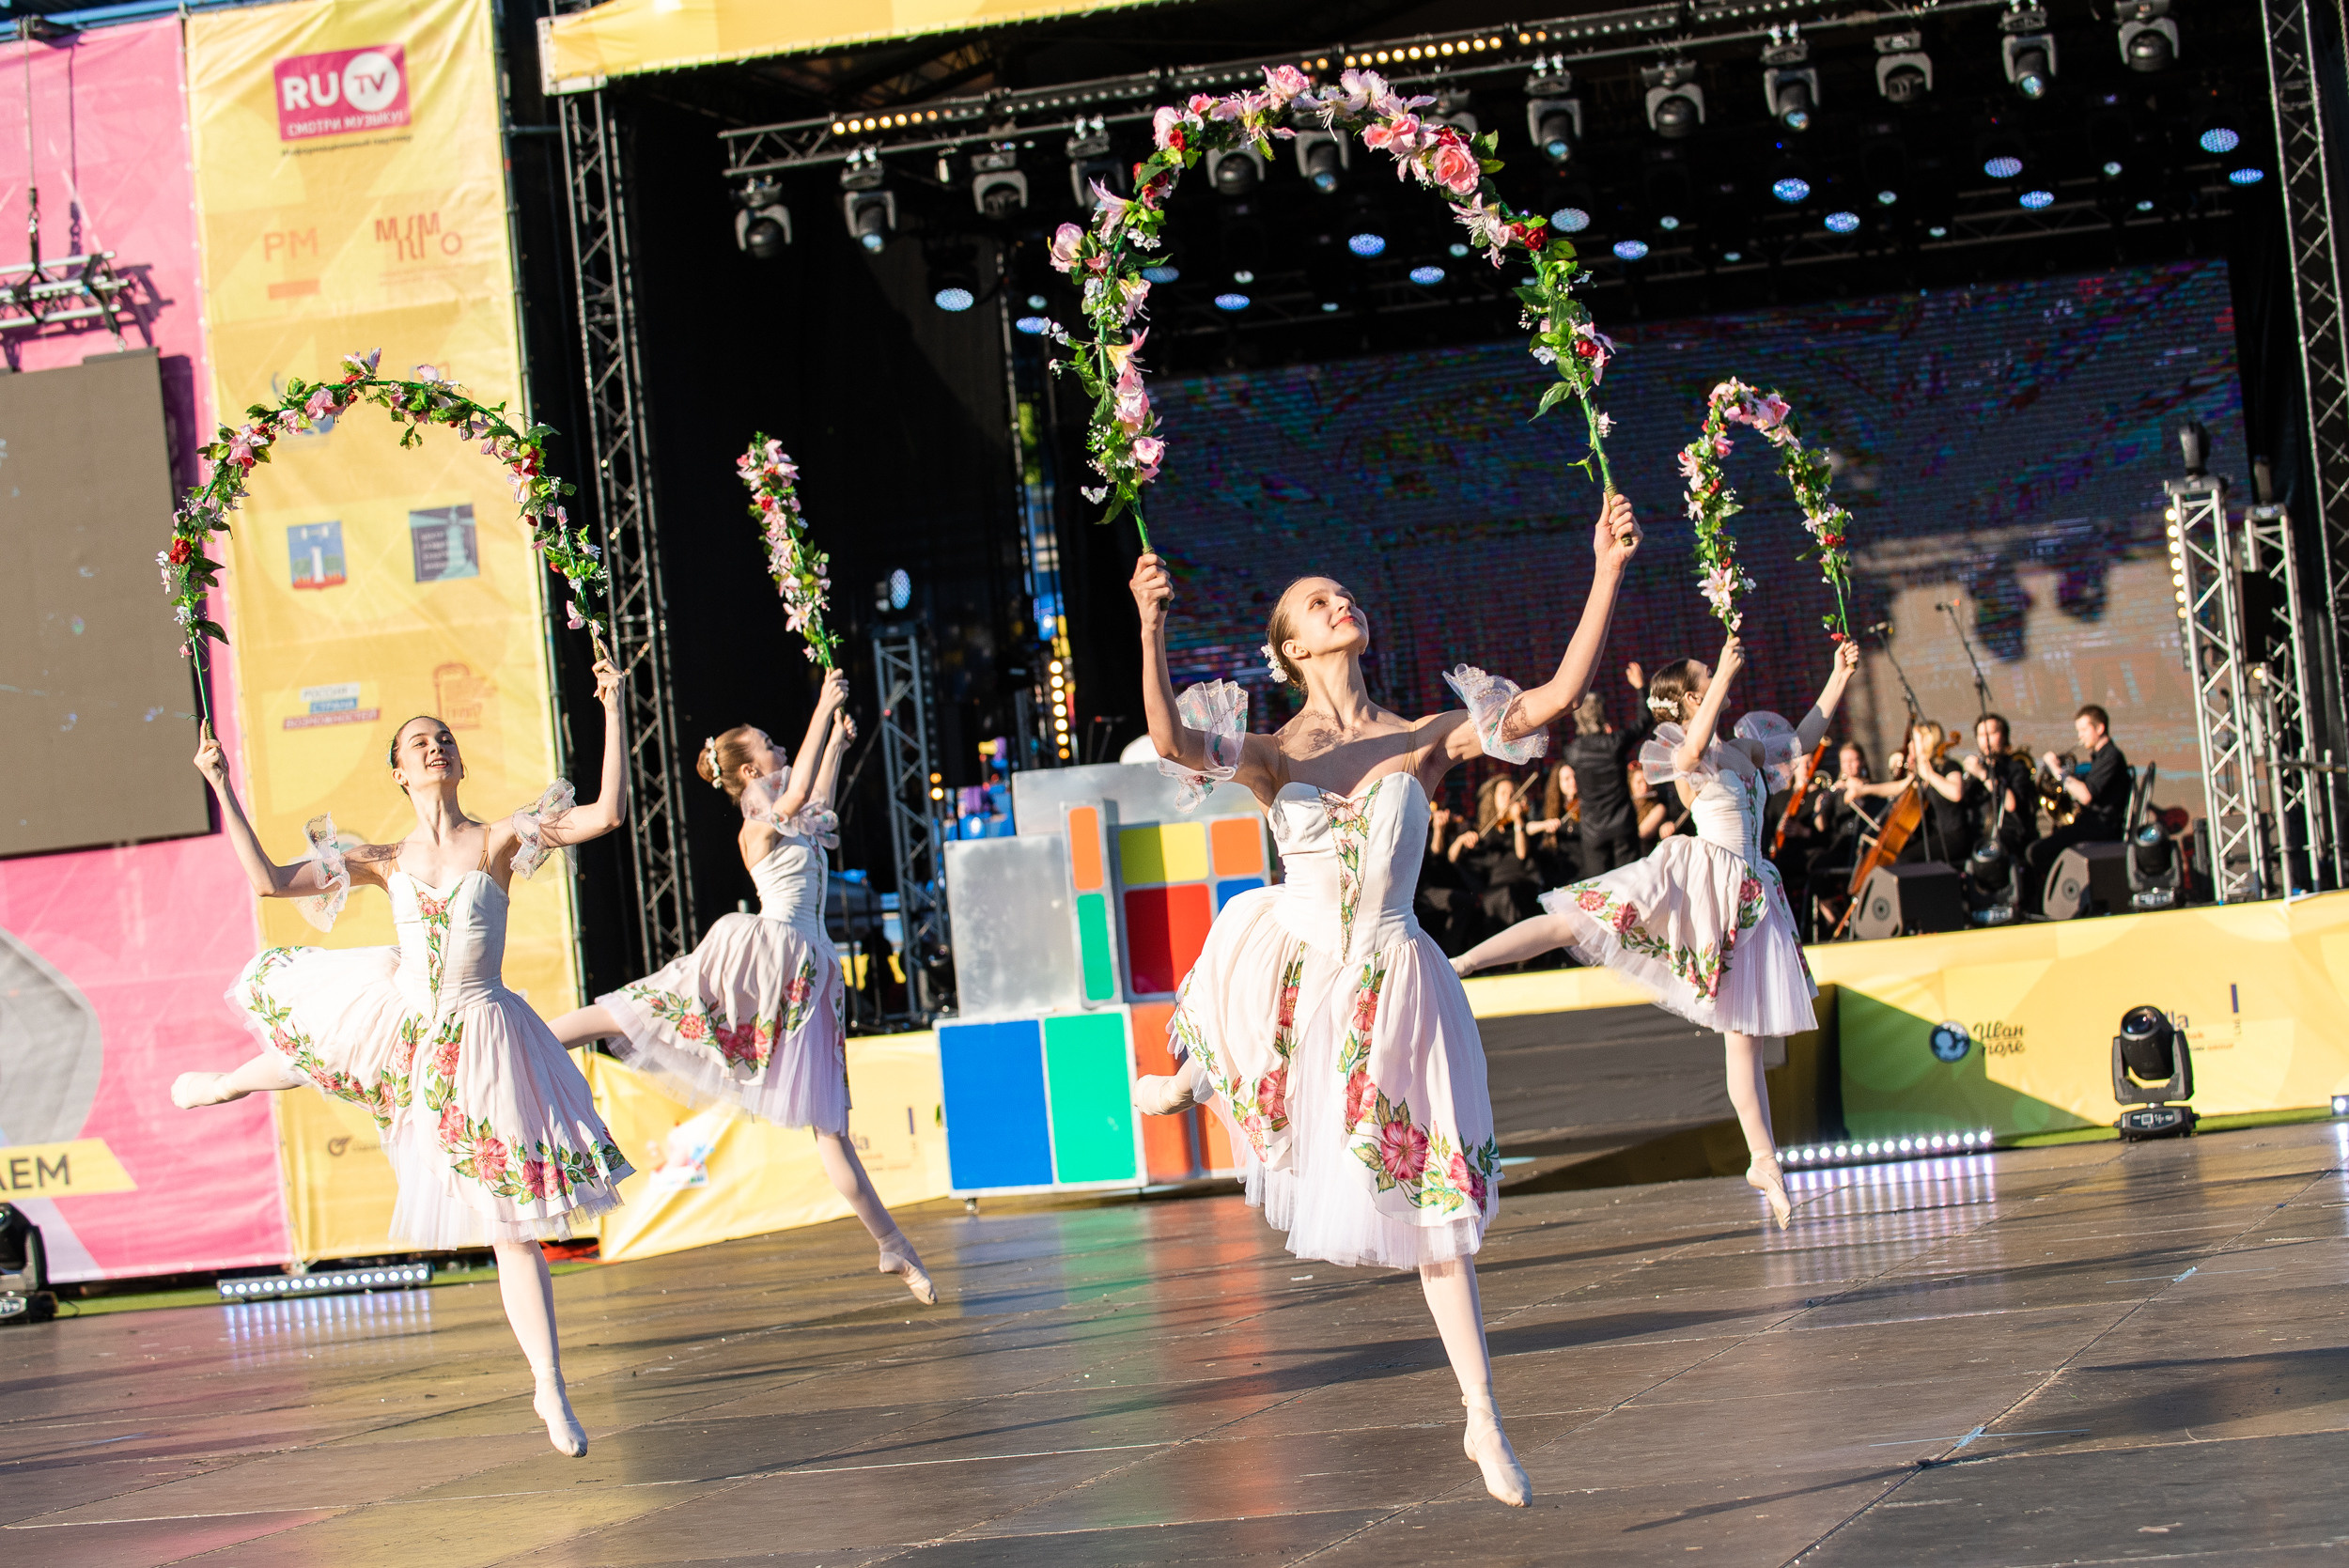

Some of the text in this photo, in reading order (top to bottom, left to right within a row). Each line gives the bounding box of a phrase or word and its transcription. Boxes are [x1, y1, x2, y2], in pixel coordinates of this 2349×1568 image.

[283, 71, 387, 112] RU TV
[287, 117, 342, 137] СМОТРИ
[0, 1153, 70, 1191] ЕМ
